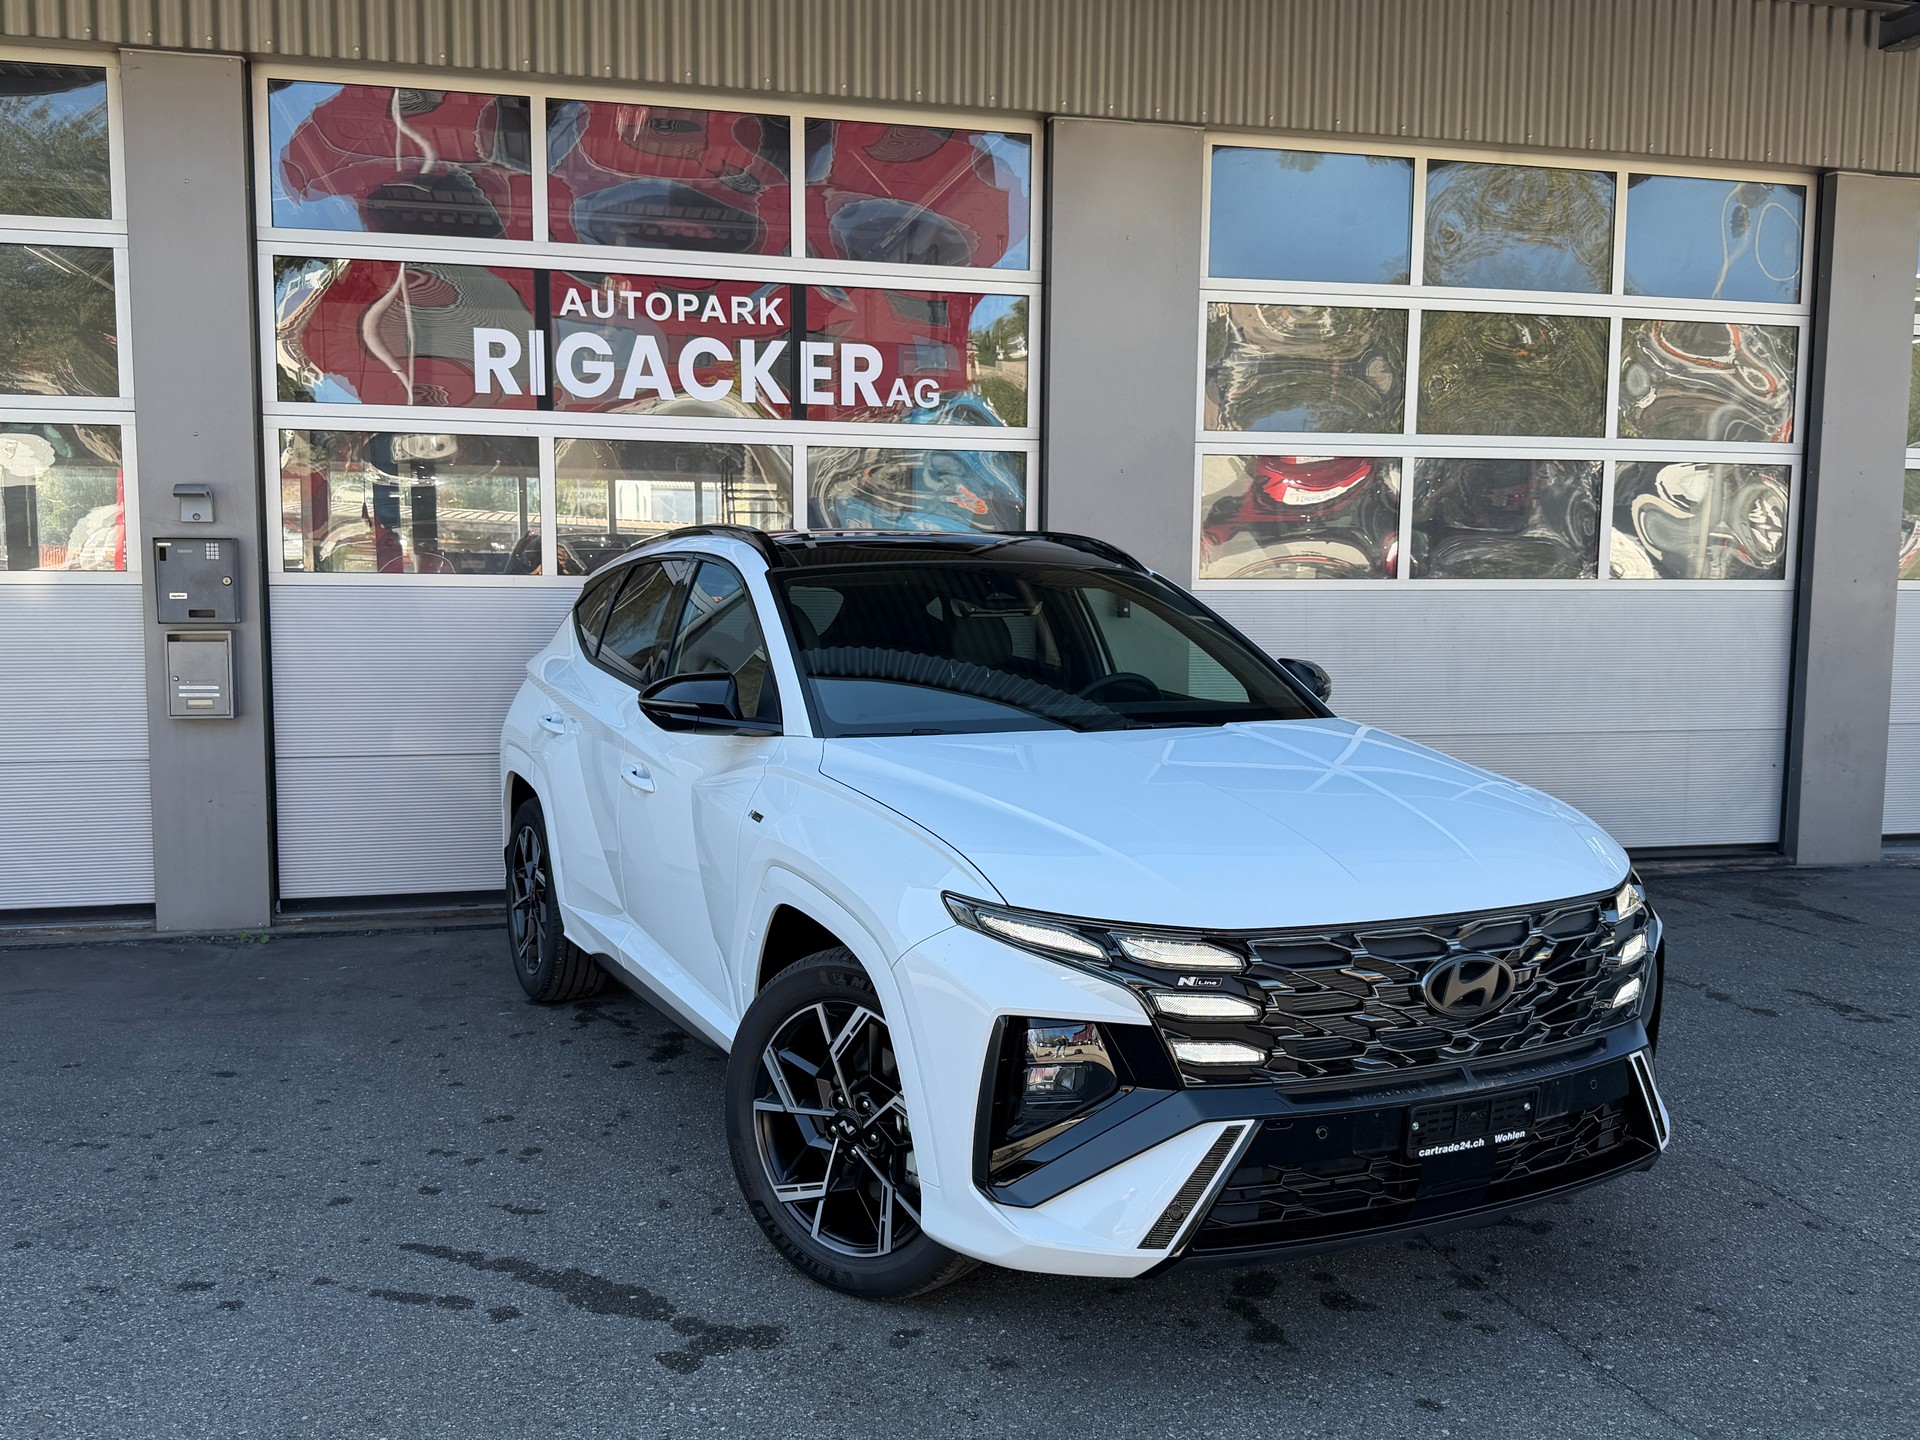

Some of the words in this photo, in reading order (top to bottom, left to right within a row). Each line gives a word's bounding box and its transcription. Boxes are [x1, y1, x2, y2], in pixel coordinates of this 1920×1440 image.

[559, 287, 784, 325] AUTOPARK
[473, 327, 884, 407] RIGACKER
[887, 377, 940, 408] AG
[1418, 1138, 1485, 1157] cartrade24.ch
[1494, 1130, 1526, 1143] Wohlen
